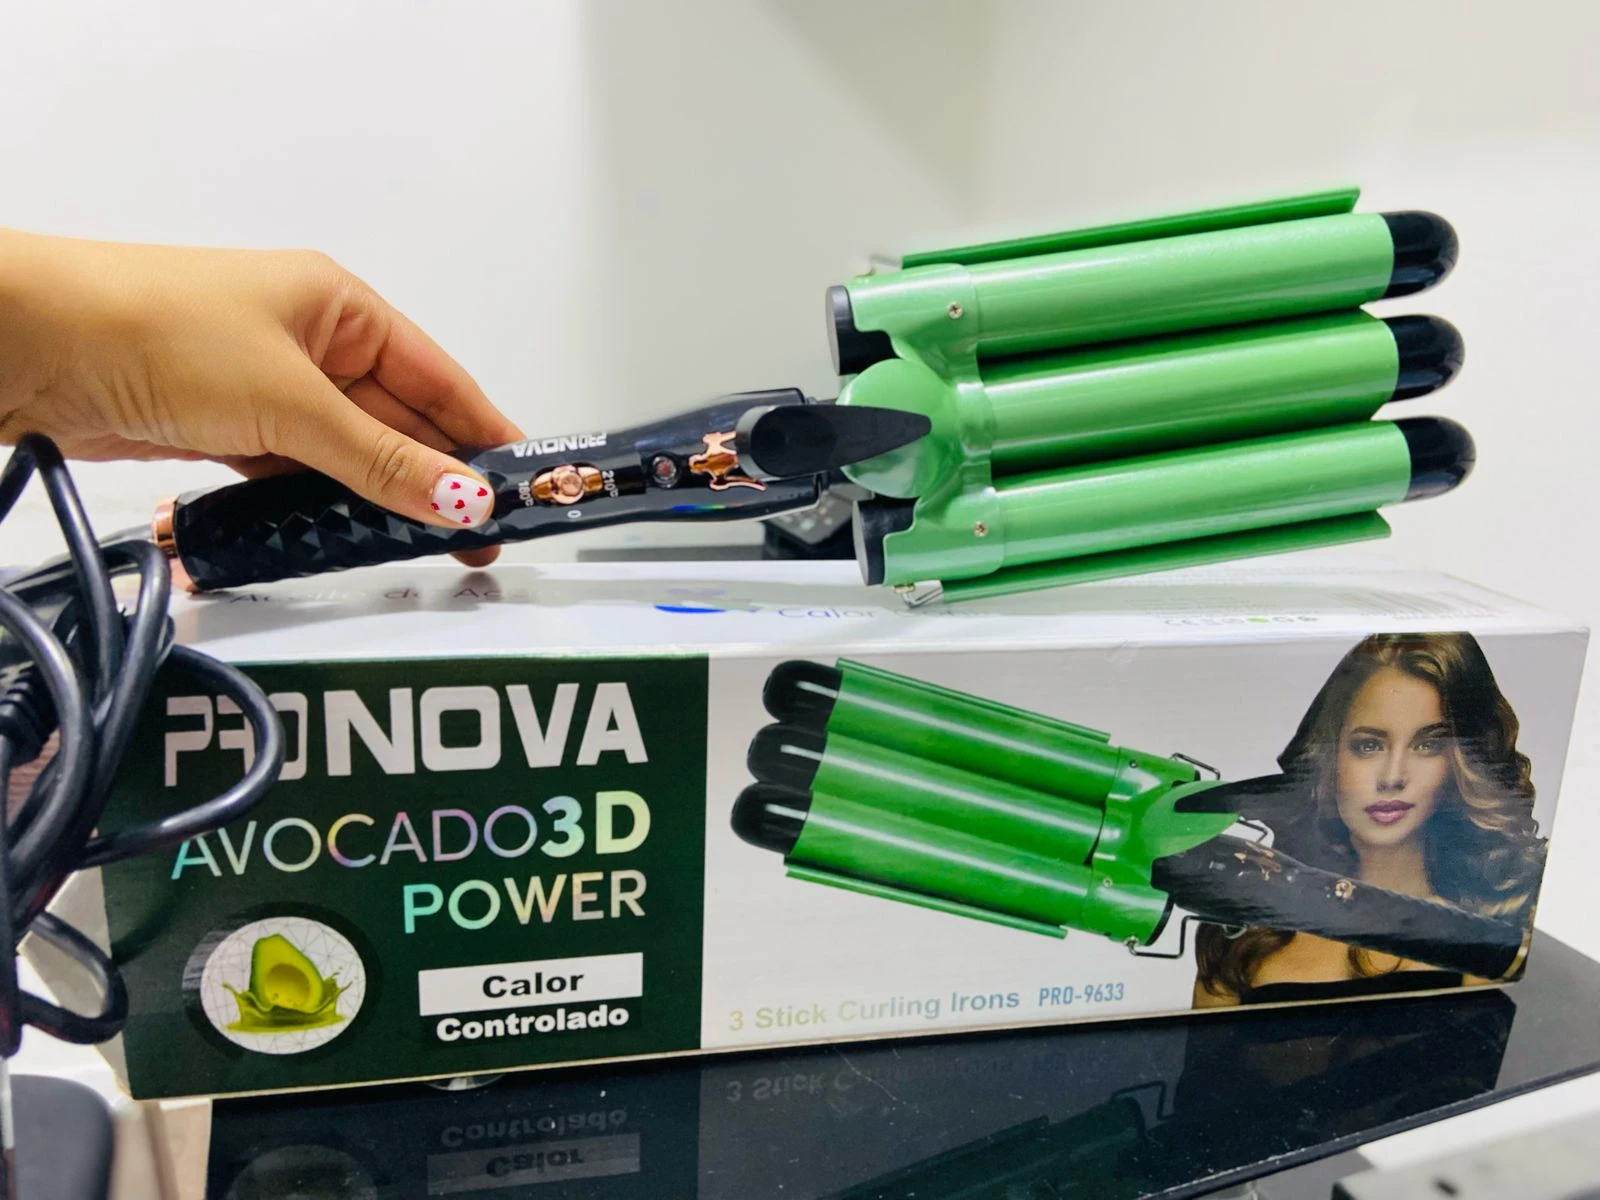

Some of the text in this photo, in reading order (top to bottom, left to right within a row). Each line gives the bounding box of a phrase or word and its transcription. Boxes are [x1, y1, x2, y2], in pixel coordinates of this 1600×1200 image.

[403, 870, 648, 934] POWER
[482, 970, 585, 999] Calor
[435, 1004, 629, 1042] Controlado
[728, 982, 1126, 1032] 3 Stick Curling Irons PRO-9633
